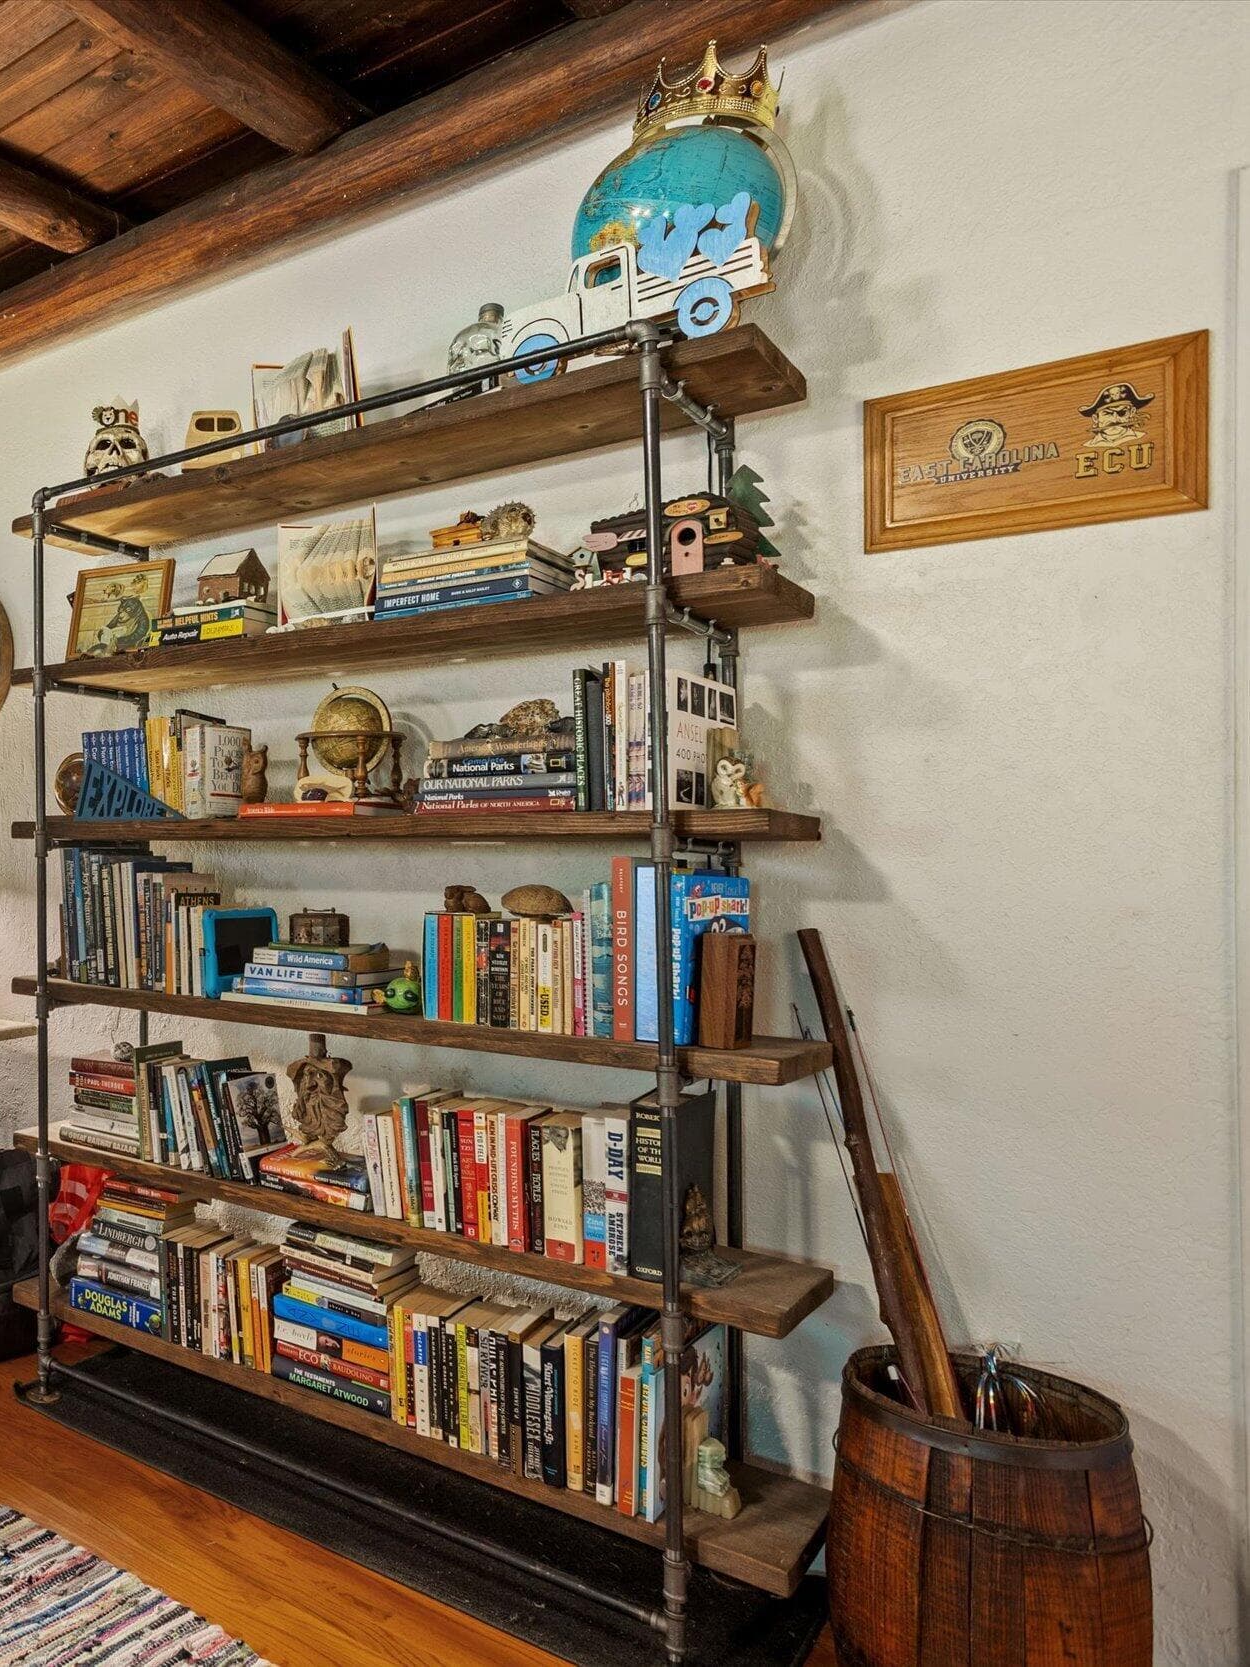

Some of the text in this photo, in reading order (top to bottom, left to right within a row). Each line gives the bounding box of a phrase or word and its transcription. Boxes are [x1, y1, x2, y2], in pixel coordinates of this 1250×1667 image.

[901, 441, 1060, 484] EAST CAROLINA
[1075, 441, 1155, 478] ECU
[938, 464, 1017, 485] UNIVERSITY
[384, 591, 440, 608] IMPERFECT HOME
[200, 611, 219, 623] HINTS
[162, 633, 178, 641] Auto
[218, 735, 241, 747] 1,000
[574, 678, 585, 787] GREAT HISTORIC PLACES
[676, 722, 703, 743] ANSEL
[452, 761, 515, 773] National Parks
[676, 749, 692, 760] 400
[213, 769, 240, 781] BEFOR
[423, 779, 443, 791] OUR
[444, 777, 490, 790] NATIONAL
[491, 775, 524, 788] PARKS
[82, 763, 167, 818] EXPLORE
[424, 792, 464, 802] National Parks
[422, 800, 455, 811] National
[457, 800, 479, 809] Parks
[83, 897, 91, 926] Nature
[180, 896, 215, 906] ATHENS
[286, 954, 303, 963] Wild
[303, 956, 334, 966] America
[616, 910, 628, 1006] BIRD SONGS
[249, 965, 273, 978] VAN
[276, 969, 304, 980] LIFE
[477, 1131, 486, 1163] SYD FIELD
[490, 1144, 498, 1174] MID-LIFE
[531, 1129, 540, 1161] PLAGUES
[607, 1131, 623, 1180] D-DAY
[510, 1141, 519, 1230] FOUNDING MYTHS
[532, 1173, 541, 1203] PEOPLES
[492, 1194, 500, 1222] CONWAY
[98, 1224, 145, 1249] LINDBERGH
[608, 1213, 616, 1257] AMBROSE
[616, 1212, 624, 1253] STEPHEN
[107, 1271, 131, 1285] JONATHAN
[635, 1266, 662, 1277] OXFORD
[84, 1288, 128, 1312] DOUGLAS
[89, 1301, 122, 1321] ADAMS
[298, 1349, 374, 1383] ECO BAUDOLINO
[480, 1336, 490, 1389] SURVIVOR
[543, 1362, 553, 1385] Kurt
[587, 1357, 596, 1389] Elephants
[600, 1349, 610, 1387] LEGENDARY
[288, 1373, 370, 1408] MARGARET ATWOOD
[293, 1367, 336, 1387] THE TESTAMENTS
[458, 1329, 469, 1428] CHUCK PALAHNIUK LULLABY
[572, 1374, 579, 1383] TO
[526, 1384, 541, 1441] MIDDLESEX
[544, 1385, 554, 1433] Vonnegut,
[587, 1398, 595, 1408] My
[587, 1409, 596, 1437] Backyard
[640, 1382, 649, 1467] BEFORE COLUMBUS
